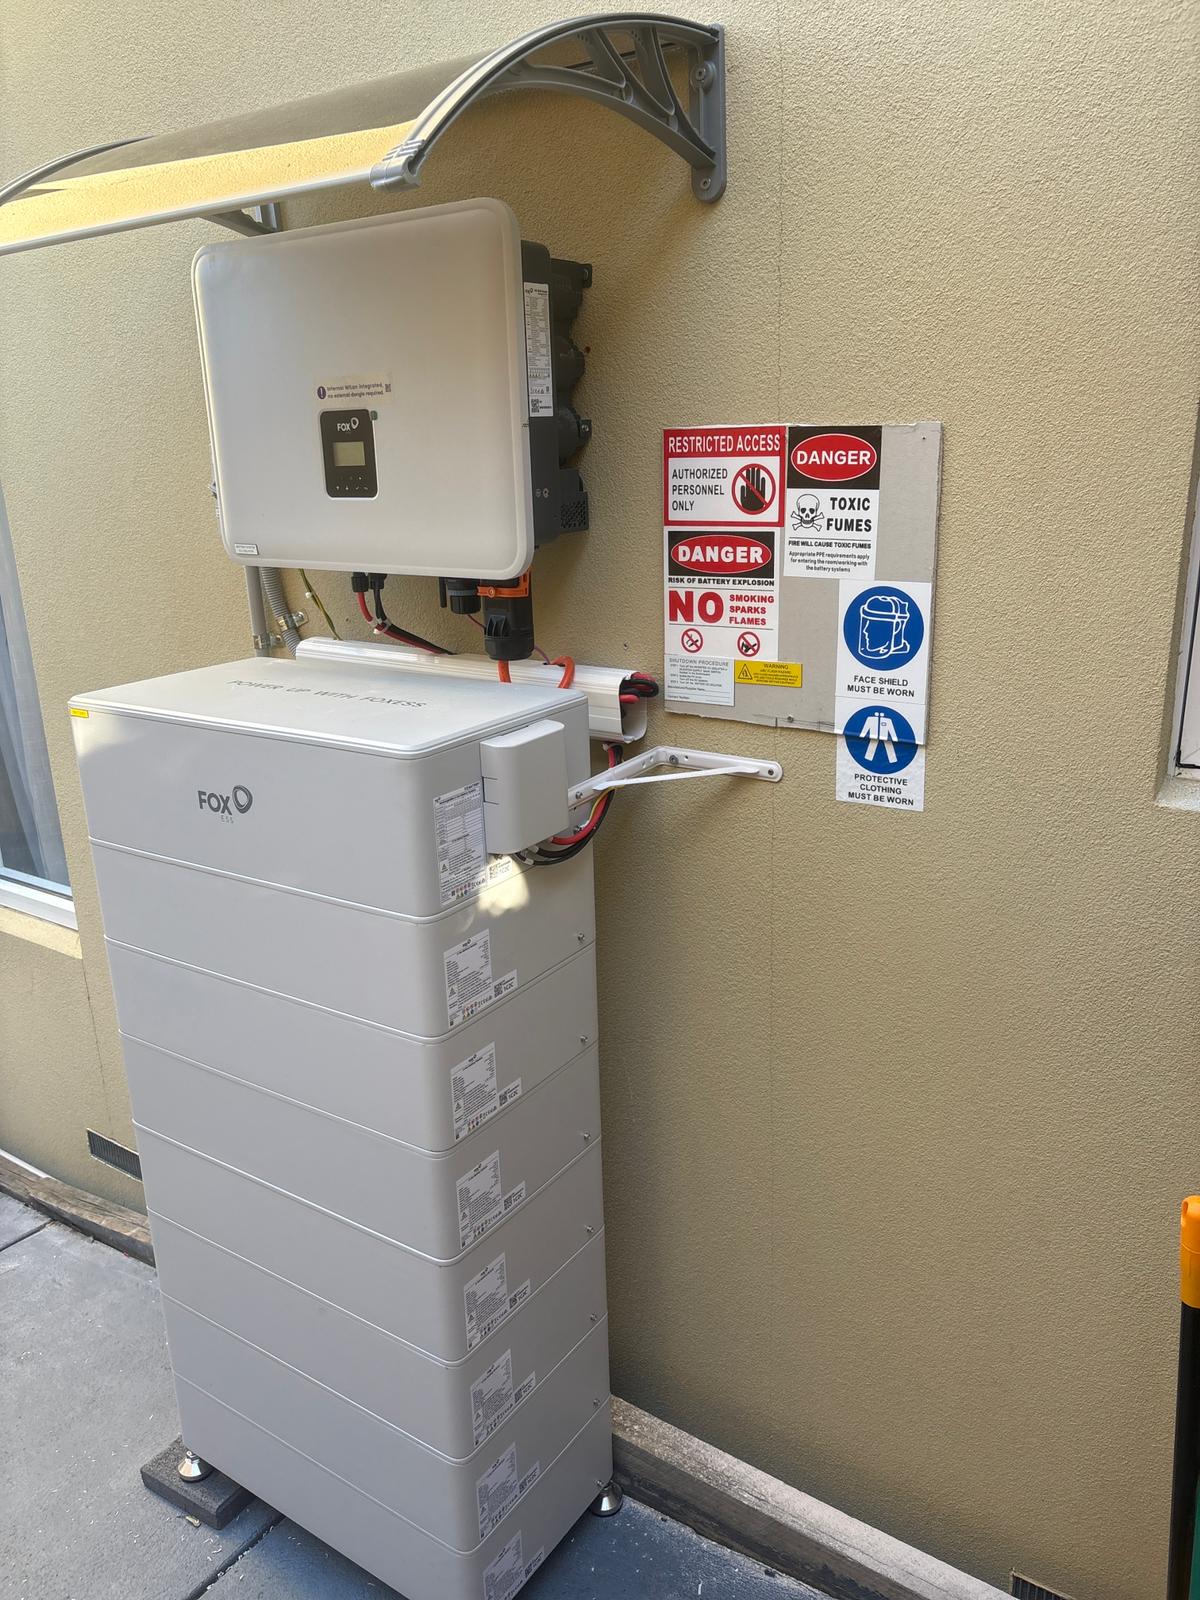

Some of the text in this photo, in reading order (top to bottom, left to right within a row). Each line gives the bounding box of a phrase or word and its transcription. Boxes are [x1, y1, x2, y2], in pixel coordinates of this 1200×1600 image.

[669, 434, 780, 453] RESTRICTED ACCESS
[797, 450, 871, 465] DANGER
[672, 468, 728, 479] AUTHORIZED
[672, 485, 725, 495] PERSONNEL
[672, 500, 694, 511] ONLY
[830, 497, 870, 511] TOXIC
[826, 518, 872, 532] FUMES
[678, 545, 763, 563] DANGER
[729, 594, 774, 603] SMOKING
[669, 590, 724, 623] NO
[729, 606, 766, 614] SPARKS
[729, 617, 766, 626] FLAMES
[854, 675, 908, 687] FACE SHIELD
[228, 680, 284, 690] POWER
[314, 690, 358, 699] WITH
[847, 684, 914, 697] MUST BE WORN
[854, 773, 908, 786] PROTECTIVE
[860, 783, 902, 795] CLOTHING
[198, 790, 233, 816] FOX
[848, 791, 872, 800] MUST
[886, 796, 914, 805] WORN
